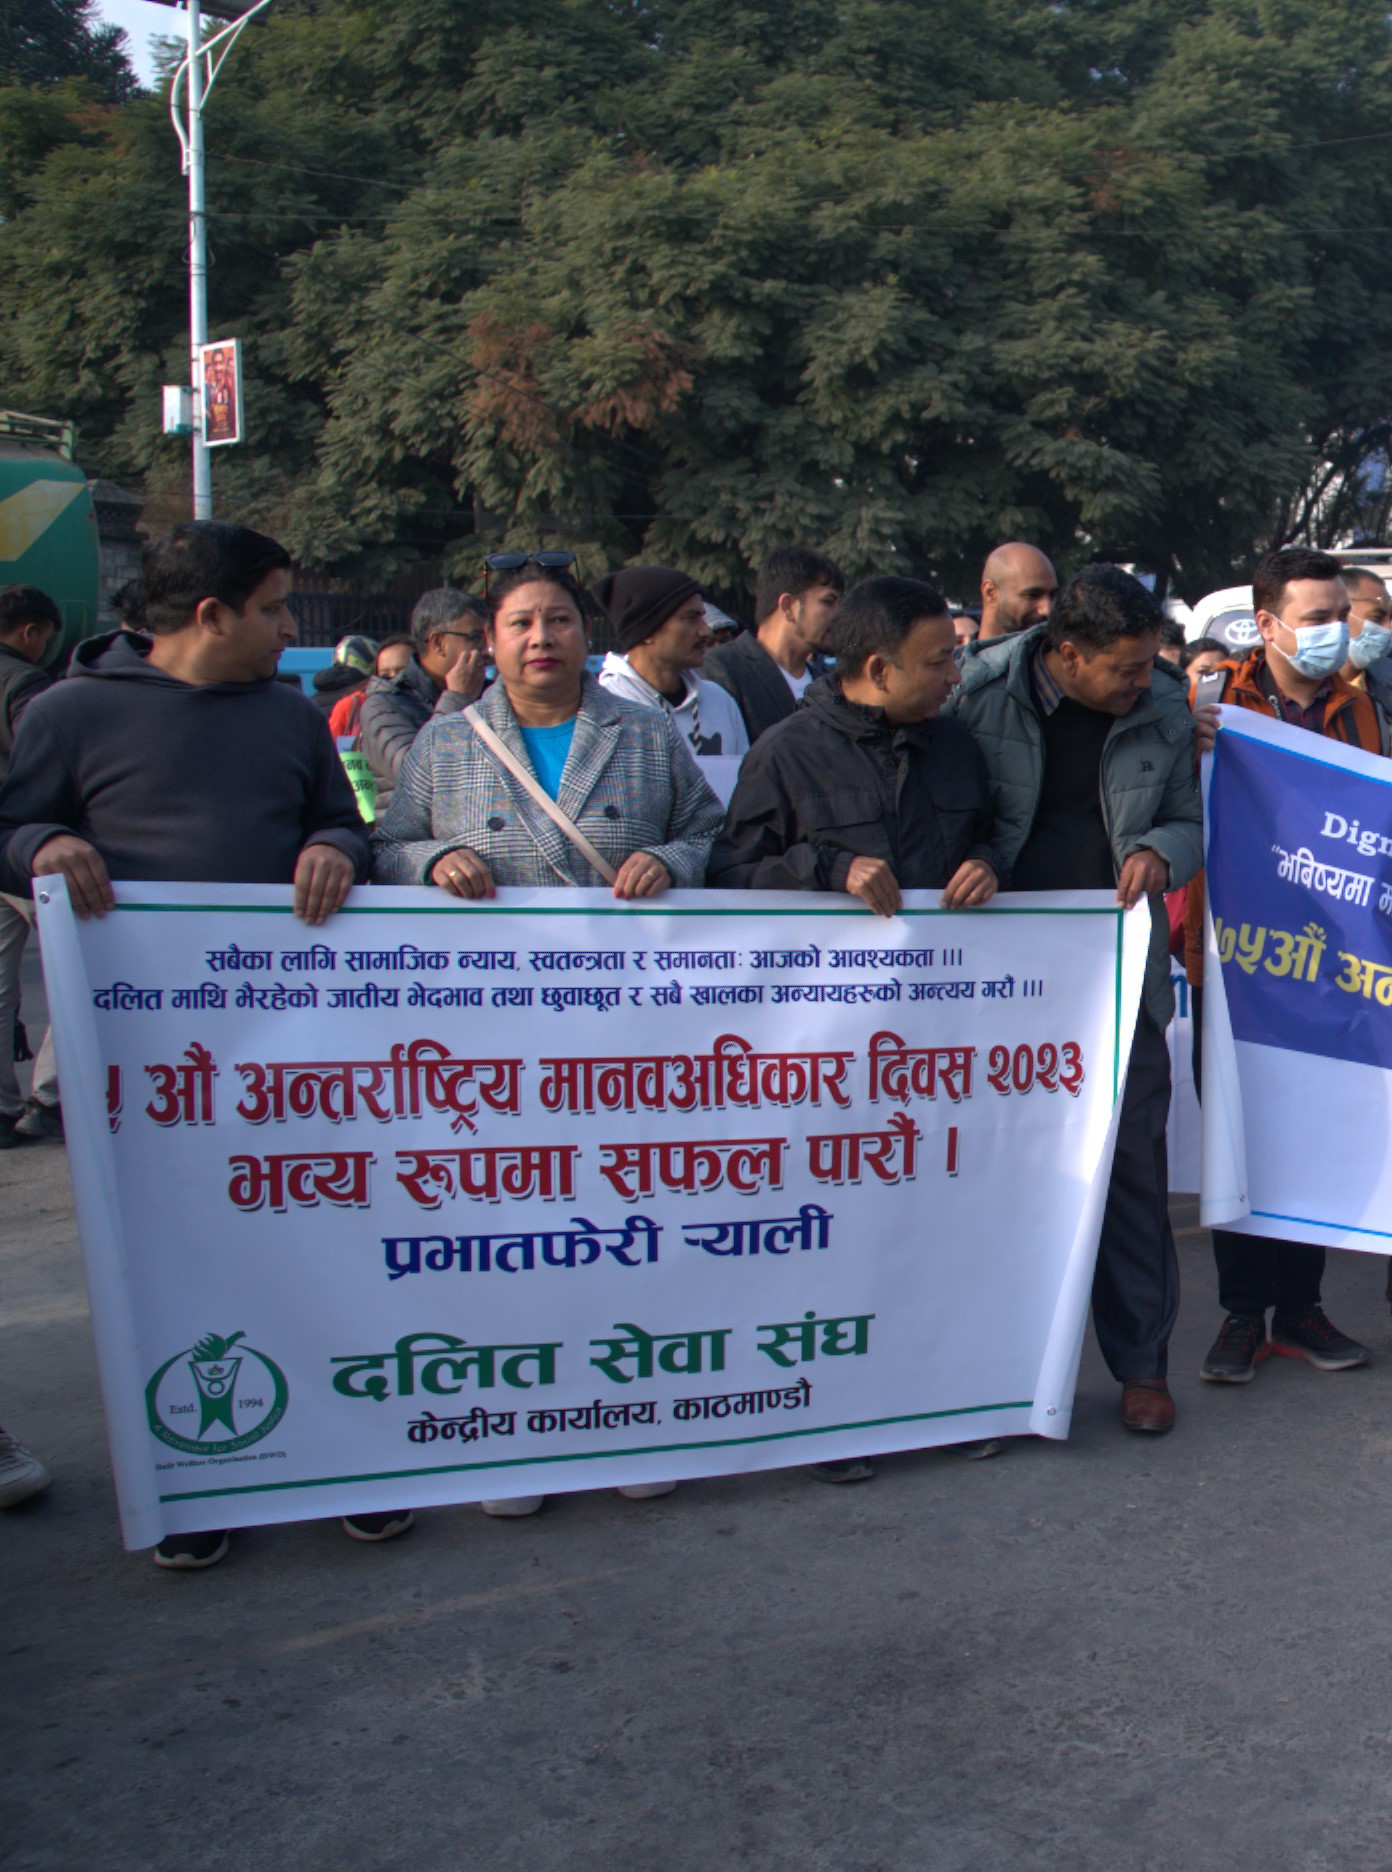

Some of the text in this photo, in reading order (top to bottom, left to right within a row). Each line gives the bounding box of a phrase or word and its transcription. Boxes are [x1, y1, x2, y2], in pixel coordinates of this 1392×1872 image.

[205, 942, 274, 972] सबैका
[280, 943, 337, 972] लागि
[344, 943, 451, 973] सामाजिक
[528, 950, 625, 972] स्वतन्त्रता
[632, 950, 647, 971] र
[749, 944, 821, 970] आजको
[827, 948, 935, 970] आवश्यकता
[92, 981, 164, 1011] दलित
[170, 982, 229, 1010] माथि
[234, 981, 320, 1010] भैरहेको
[325, 983, 401, 1009] जातीय
[406, 981, 484, 1009] भेदभाव
[490, 987, 535, 1008] तथा
[628, 986, 644, 1008] र
[649, 979, 684, 1008] सबै
[690, 984, 765, 1006] खालका
[538, 1033, 855, 1116] मानवअधिकार
[867, 1030, 977, 1106] दिवस
[987, 1041, 1085, 1099] २०२३
[227, 1150, 376, 1212] भव्य
[599, 1136, 790, 1202] सफल
[382, 1214, 663, 1280] प्रभातफेरी
[331, 1311, 876, 1402] दलित सेवा संघ
[239, 1398, 264, 1408] 1994
[407, 1407, 516, 1444] केन्द्रीय
